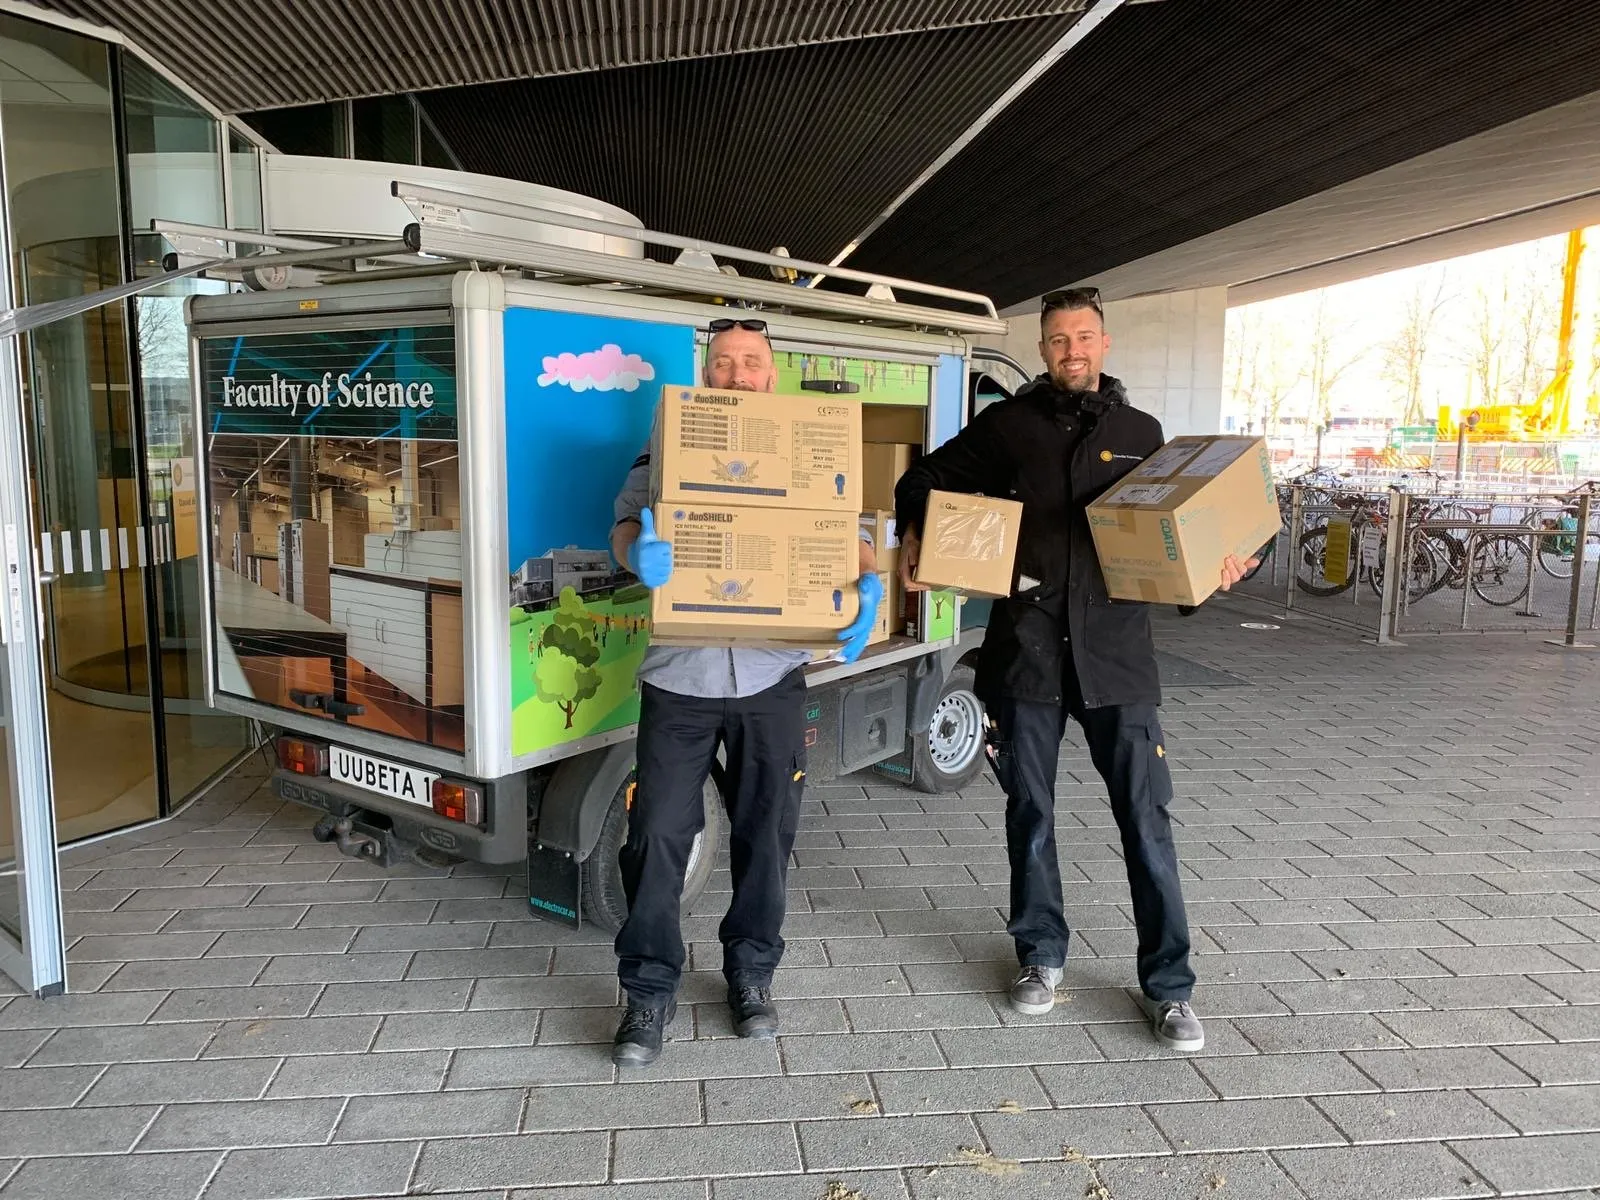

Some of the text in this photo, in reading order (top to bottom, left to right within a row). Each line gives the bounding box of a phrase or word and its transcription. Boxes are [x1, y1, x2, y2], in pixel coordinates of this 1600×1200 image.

[222, 372, 434, 416] Faculty of Science
[1259, 447, 1275, 504] COATED
[1160, 518, 1178, 561] COATED
[338, 752, 430, 802] UUBETA 1
